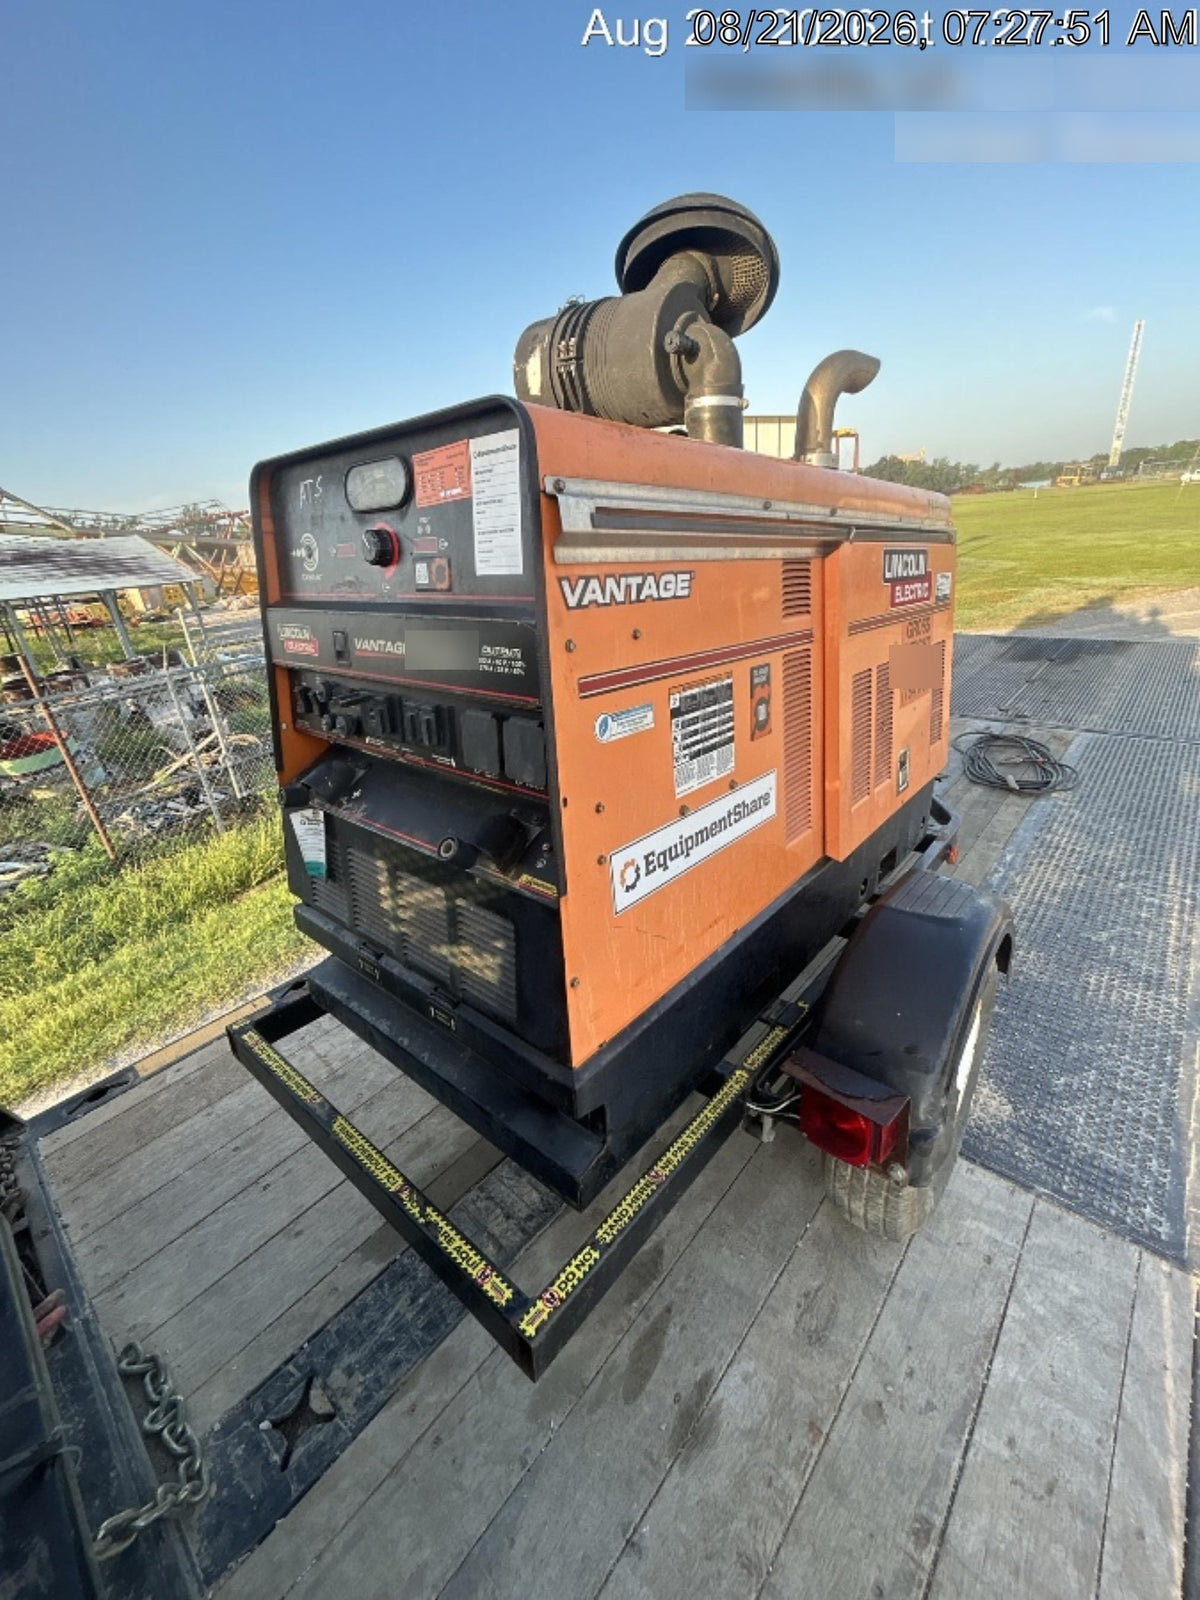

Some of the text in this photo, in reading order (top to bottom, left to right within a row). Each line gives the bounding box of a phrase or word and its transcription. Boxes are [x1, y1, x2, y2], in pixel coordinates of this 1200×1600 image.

[885, 553, 926, 579] LINCOLN
[560, 572, 691, 608] VANTAGE
[894, 582, 929, 604] ELECTRIC
[642, 789, 772, 878] EquipmentShare
[597, 1206, 630, 1244] STAND
[555, 1249, 594, 1293] DO NO
